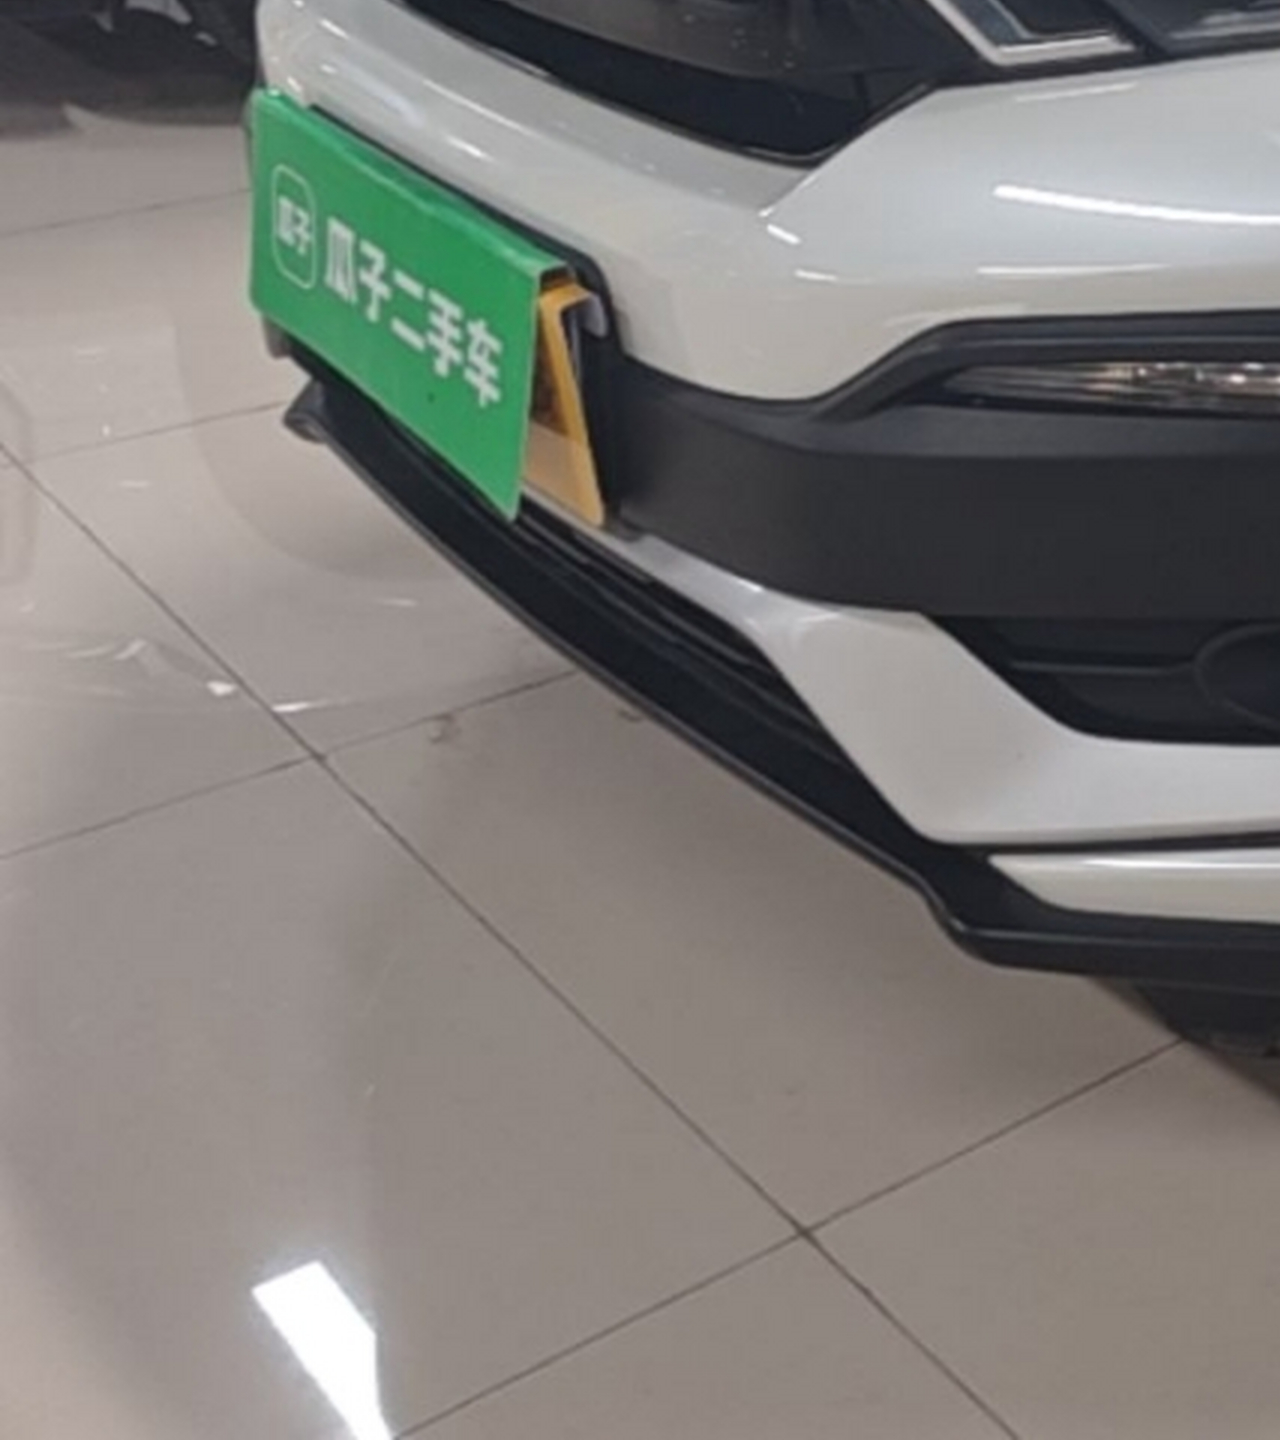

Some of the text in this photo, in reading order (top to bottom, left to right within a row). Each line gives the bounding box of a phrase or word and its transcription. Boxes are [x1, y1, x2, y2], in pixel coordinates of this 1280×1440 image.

[325, 215, 502, 408] 瓜子二手车
